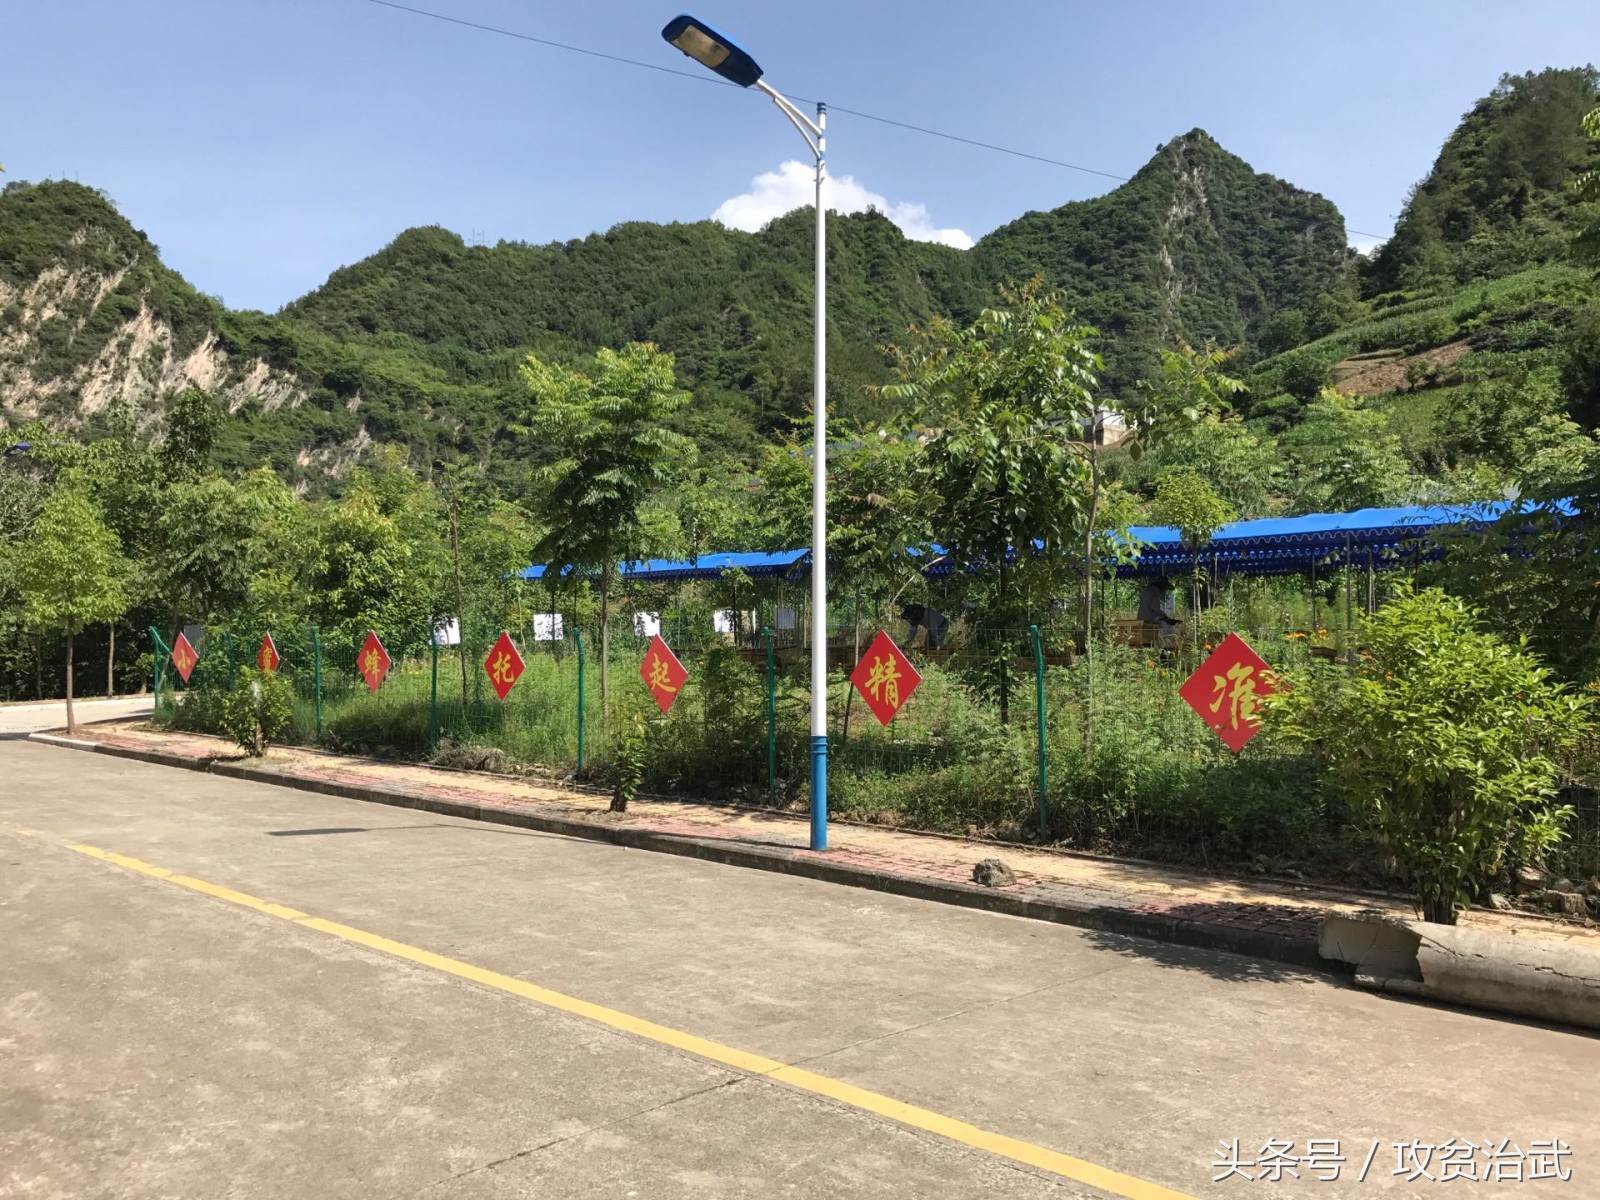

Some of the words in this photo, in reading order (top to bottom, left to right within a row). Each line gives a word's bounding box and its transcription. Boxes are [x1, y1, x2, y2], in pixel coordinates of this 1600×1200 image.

[177, 650, 191, 670] 小
[364, 648, 381, 682] 蜂
[493, 653, 513, 684] 托
[649, 652, 678, 692] 起
[864, 653, 902, 709] 精
[1209, 662, 1257, 731] 准
